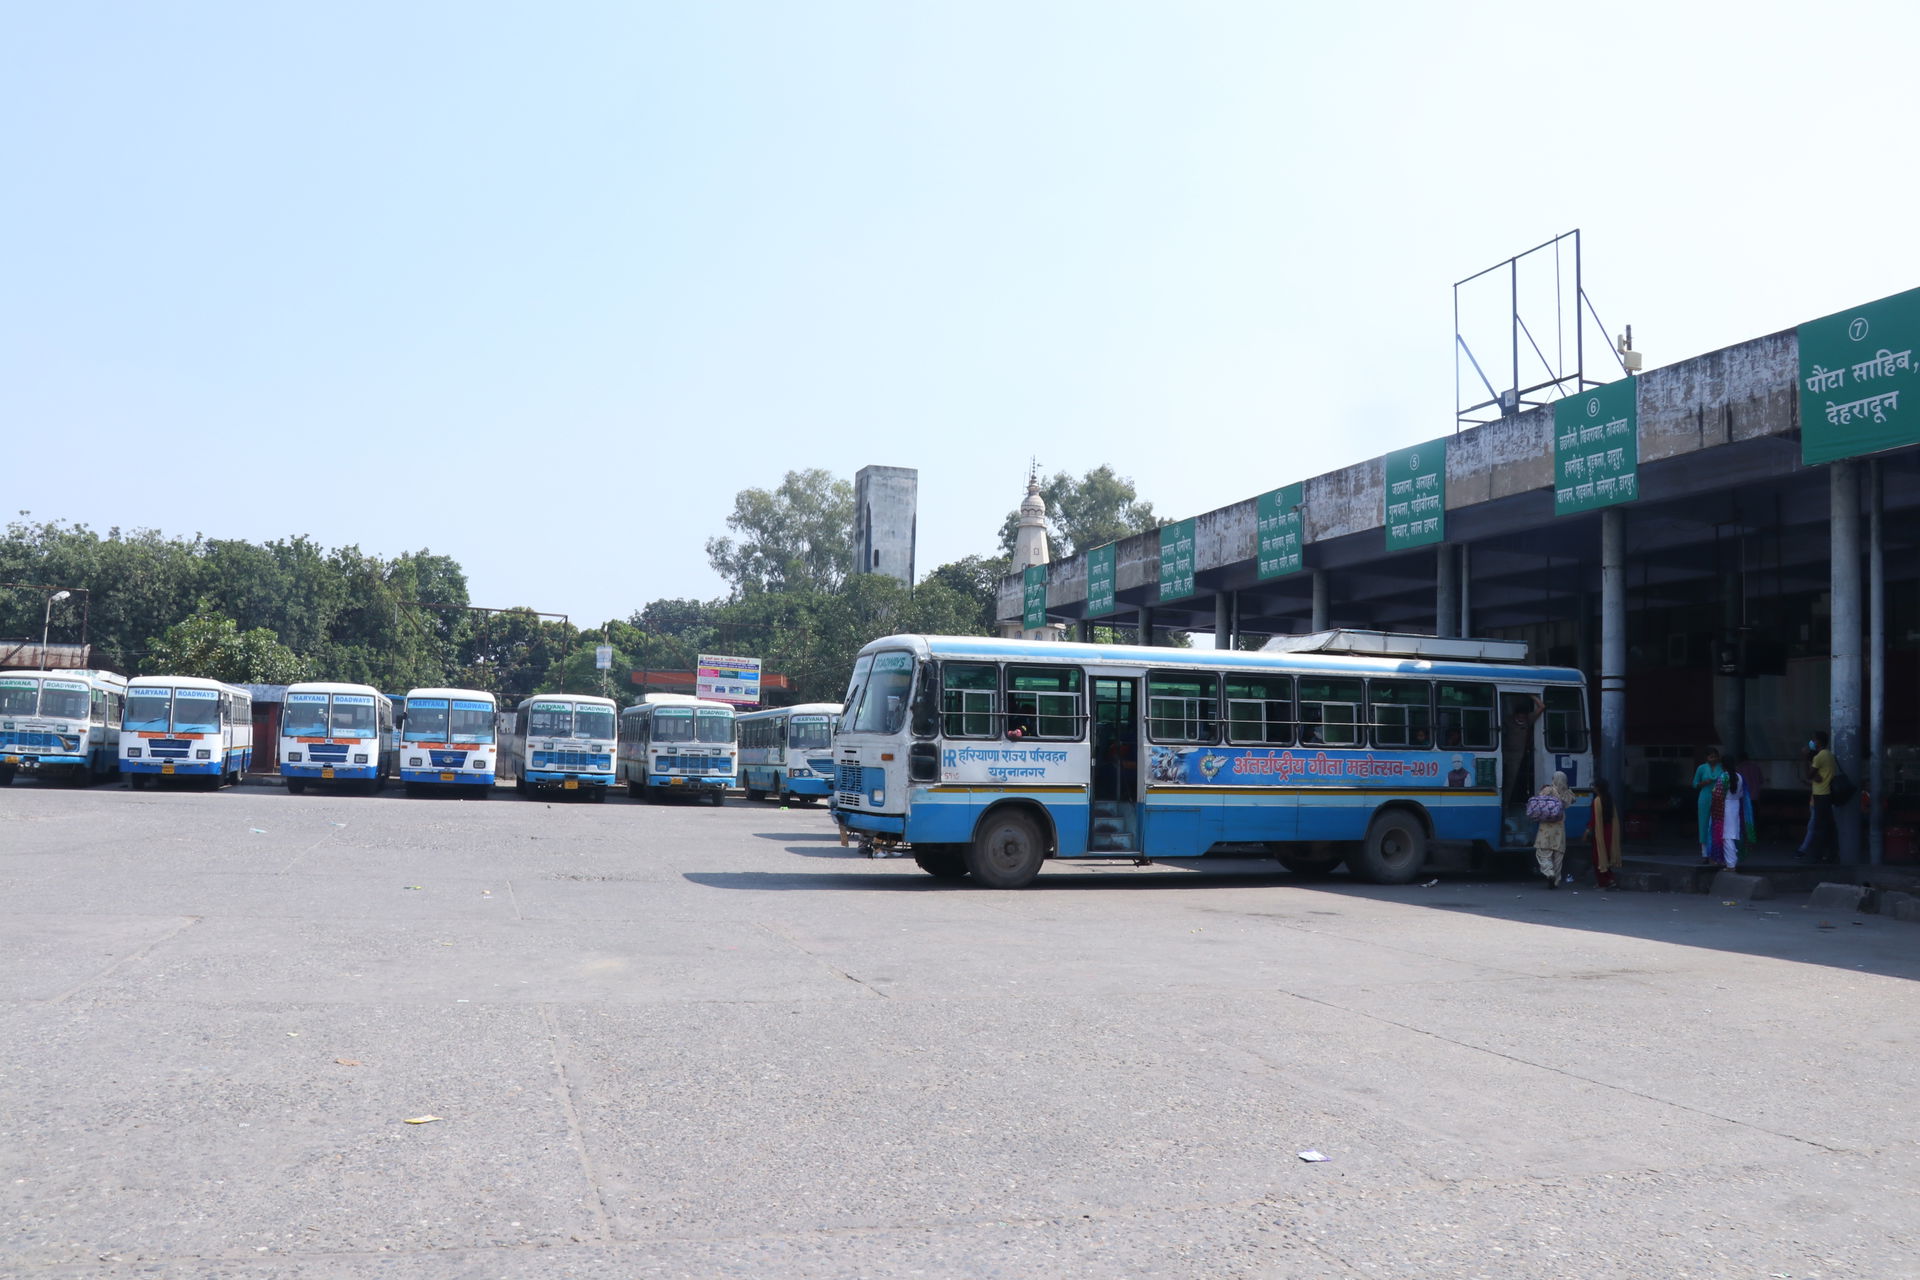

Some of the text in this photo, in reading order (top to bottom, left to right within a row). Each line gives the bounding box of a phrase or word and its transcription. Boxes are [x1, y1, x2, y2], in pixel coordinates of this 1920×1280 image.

[1806, 365, 1845, 394] पौंटा
[1825, 390, 1899, 425] देहरादून
[1410, 521, 1422, 536] लाल
[178, 690, 215, 698] ROADWAYS
[454, 702, 490, 710] ROADWAYS
[579, 705, 611, 713] ROADWAYS
[943, 749, 956, 767] HR
[958, 746, 1068, 766] हरियाणा राज्य परिवहन
[1308, 752, 1343, 776] गीता
[988, 767, 1046, 782] यमुनानगर
